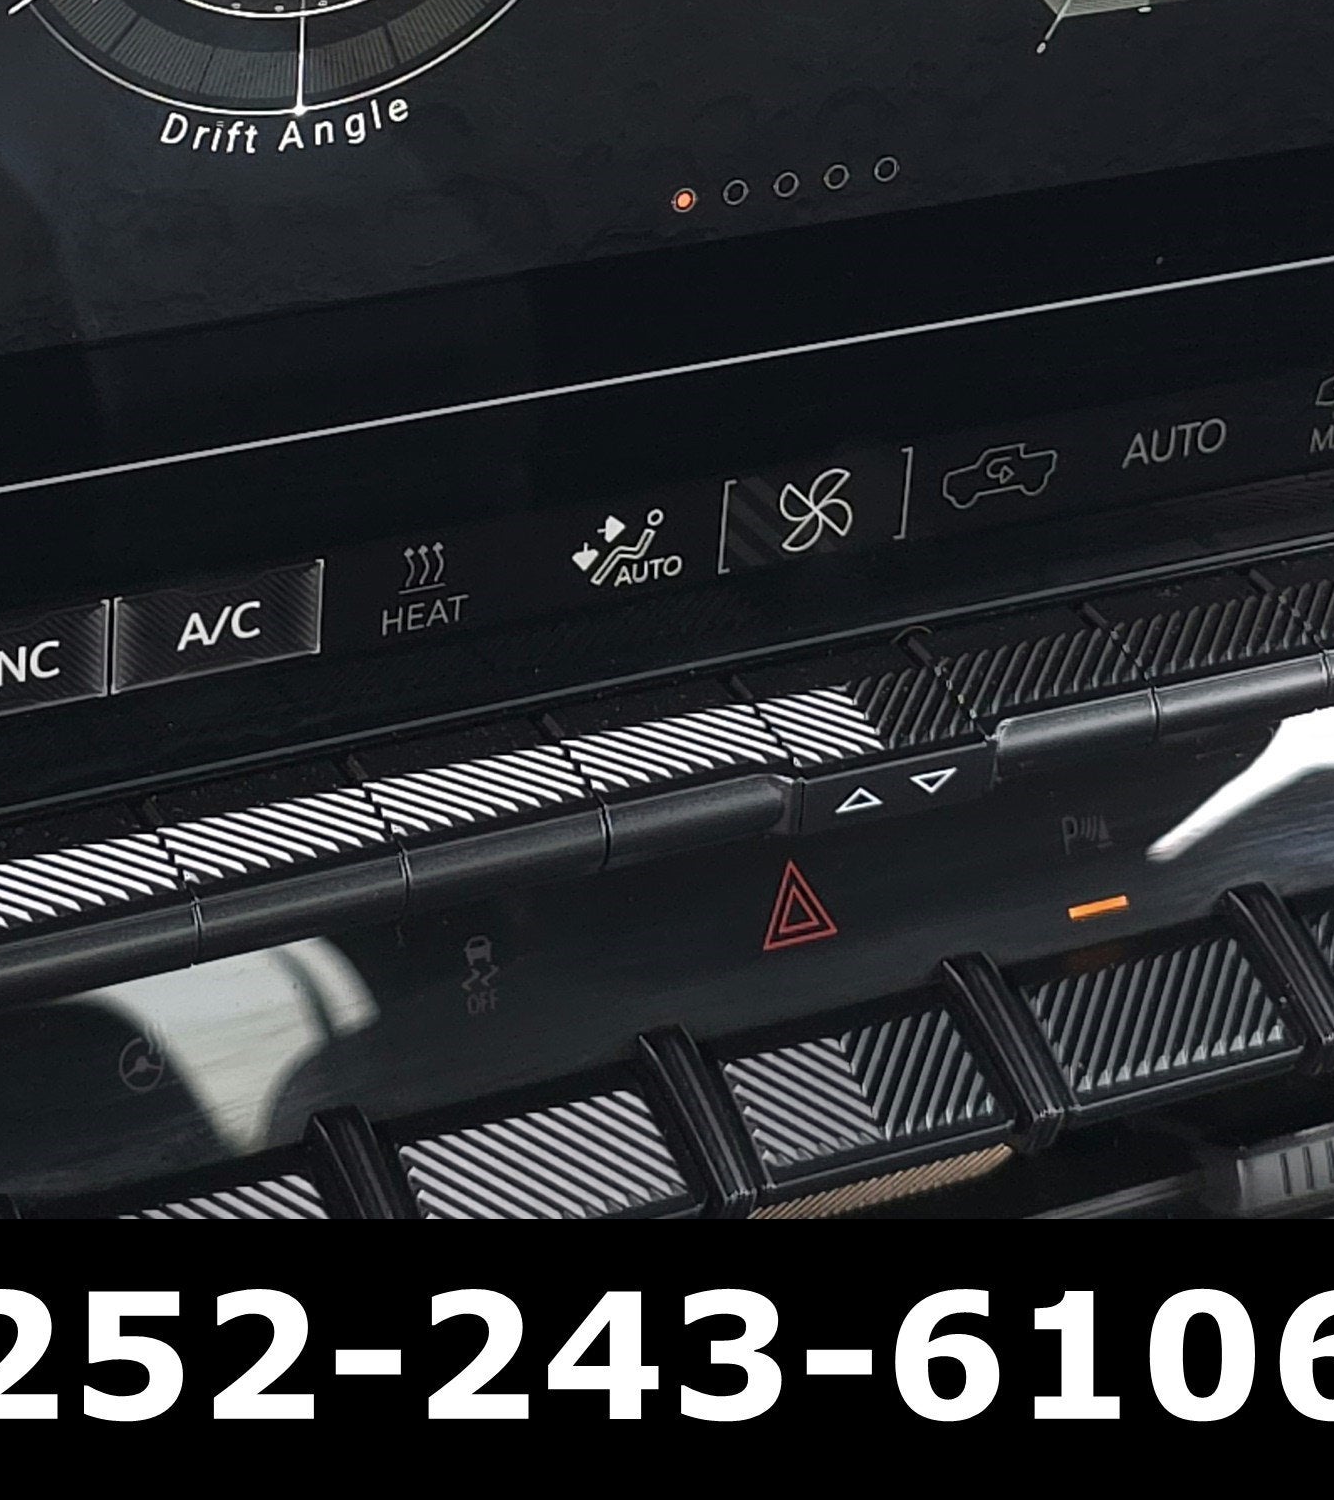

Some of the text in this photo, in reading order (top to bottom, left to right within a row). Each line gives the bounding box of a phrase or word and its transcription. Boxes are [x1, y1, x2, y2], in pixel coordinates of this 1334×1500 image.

[159, 94, 411, 157] Drift Angle
[1121, 415, 1229, 470] AUTO
[613, 553, 684, 588] AUTO
[176, 599, 262, 652] A/C
[380, 592, 471, 637] HEAT
[467, 988, 499, 1014] OFF
